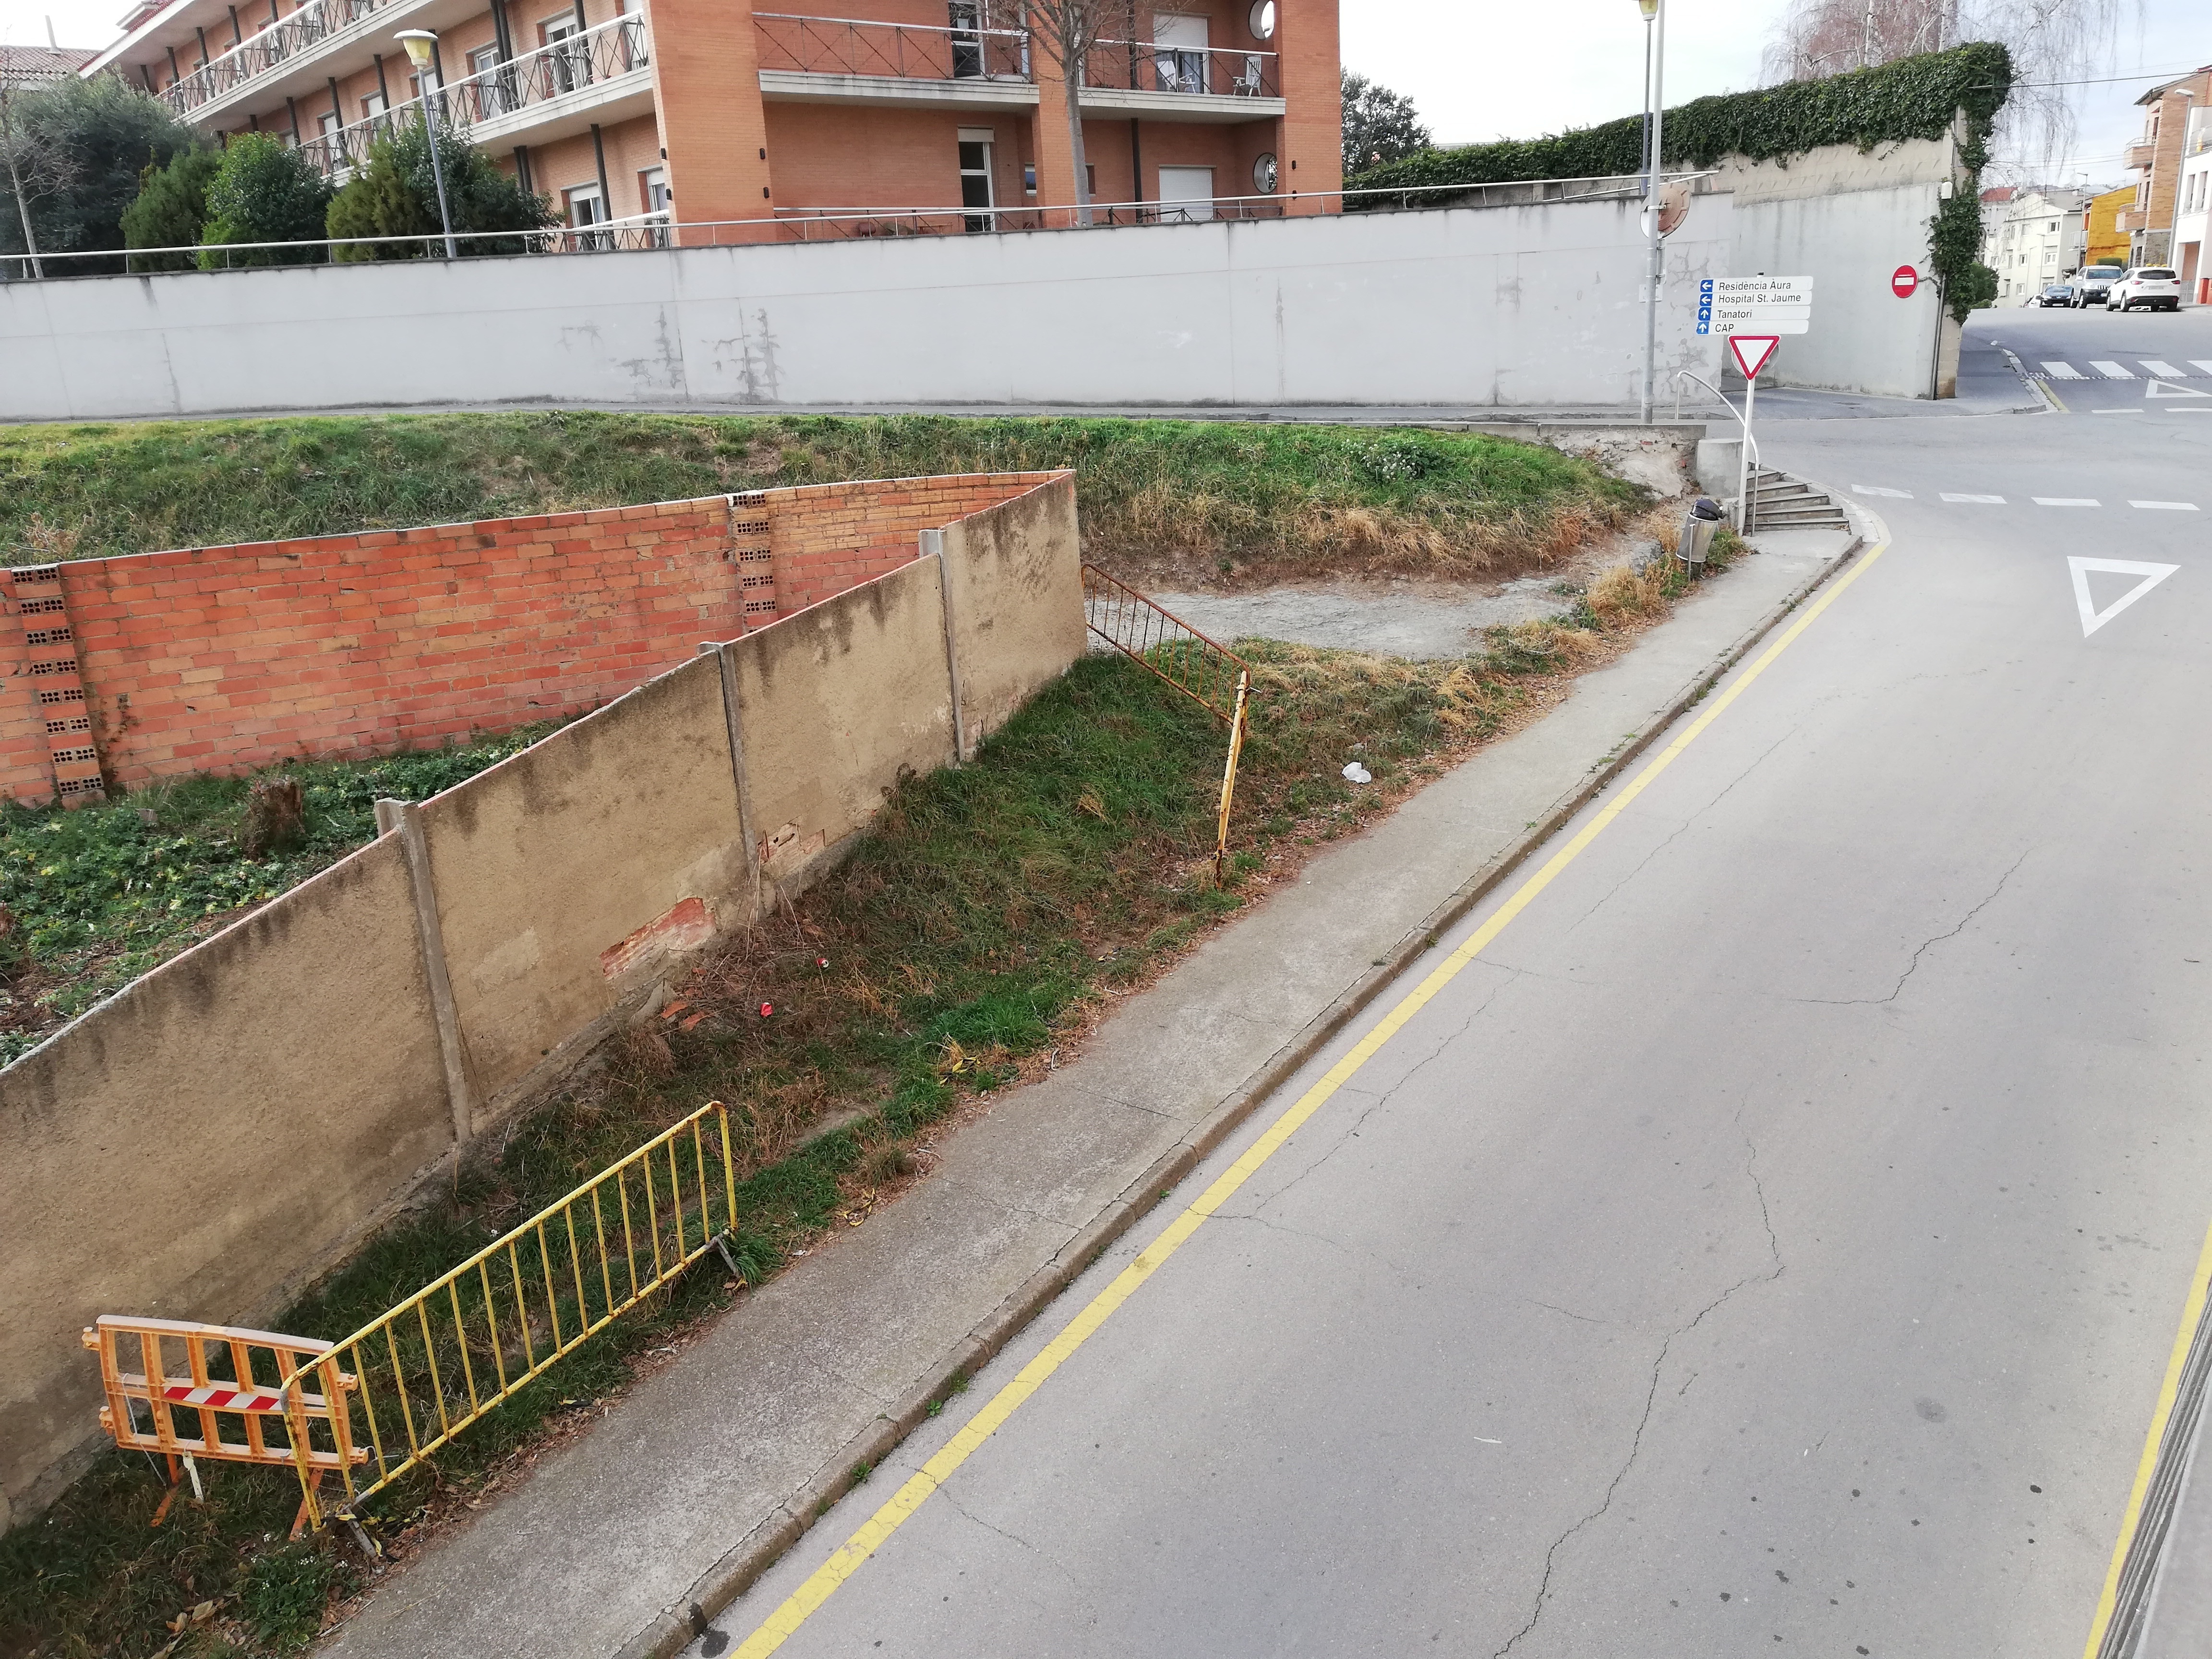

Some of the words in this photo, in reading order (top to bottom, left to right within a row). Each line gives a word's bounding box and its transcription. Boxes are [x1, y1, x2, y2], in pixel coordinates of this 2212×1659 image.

[1719, 281, 1767, 290] Residència
[1770, 278, 1791, 289] Àura
[1719, 294, 1755, 305] Hospital
[1757, 294, 1768, 302] St.
[1771, 294, 1801, 302] Jaume
[1717, 309, 1752, 318] Tanatori
[1715, 324, 1734, 332] CAP
